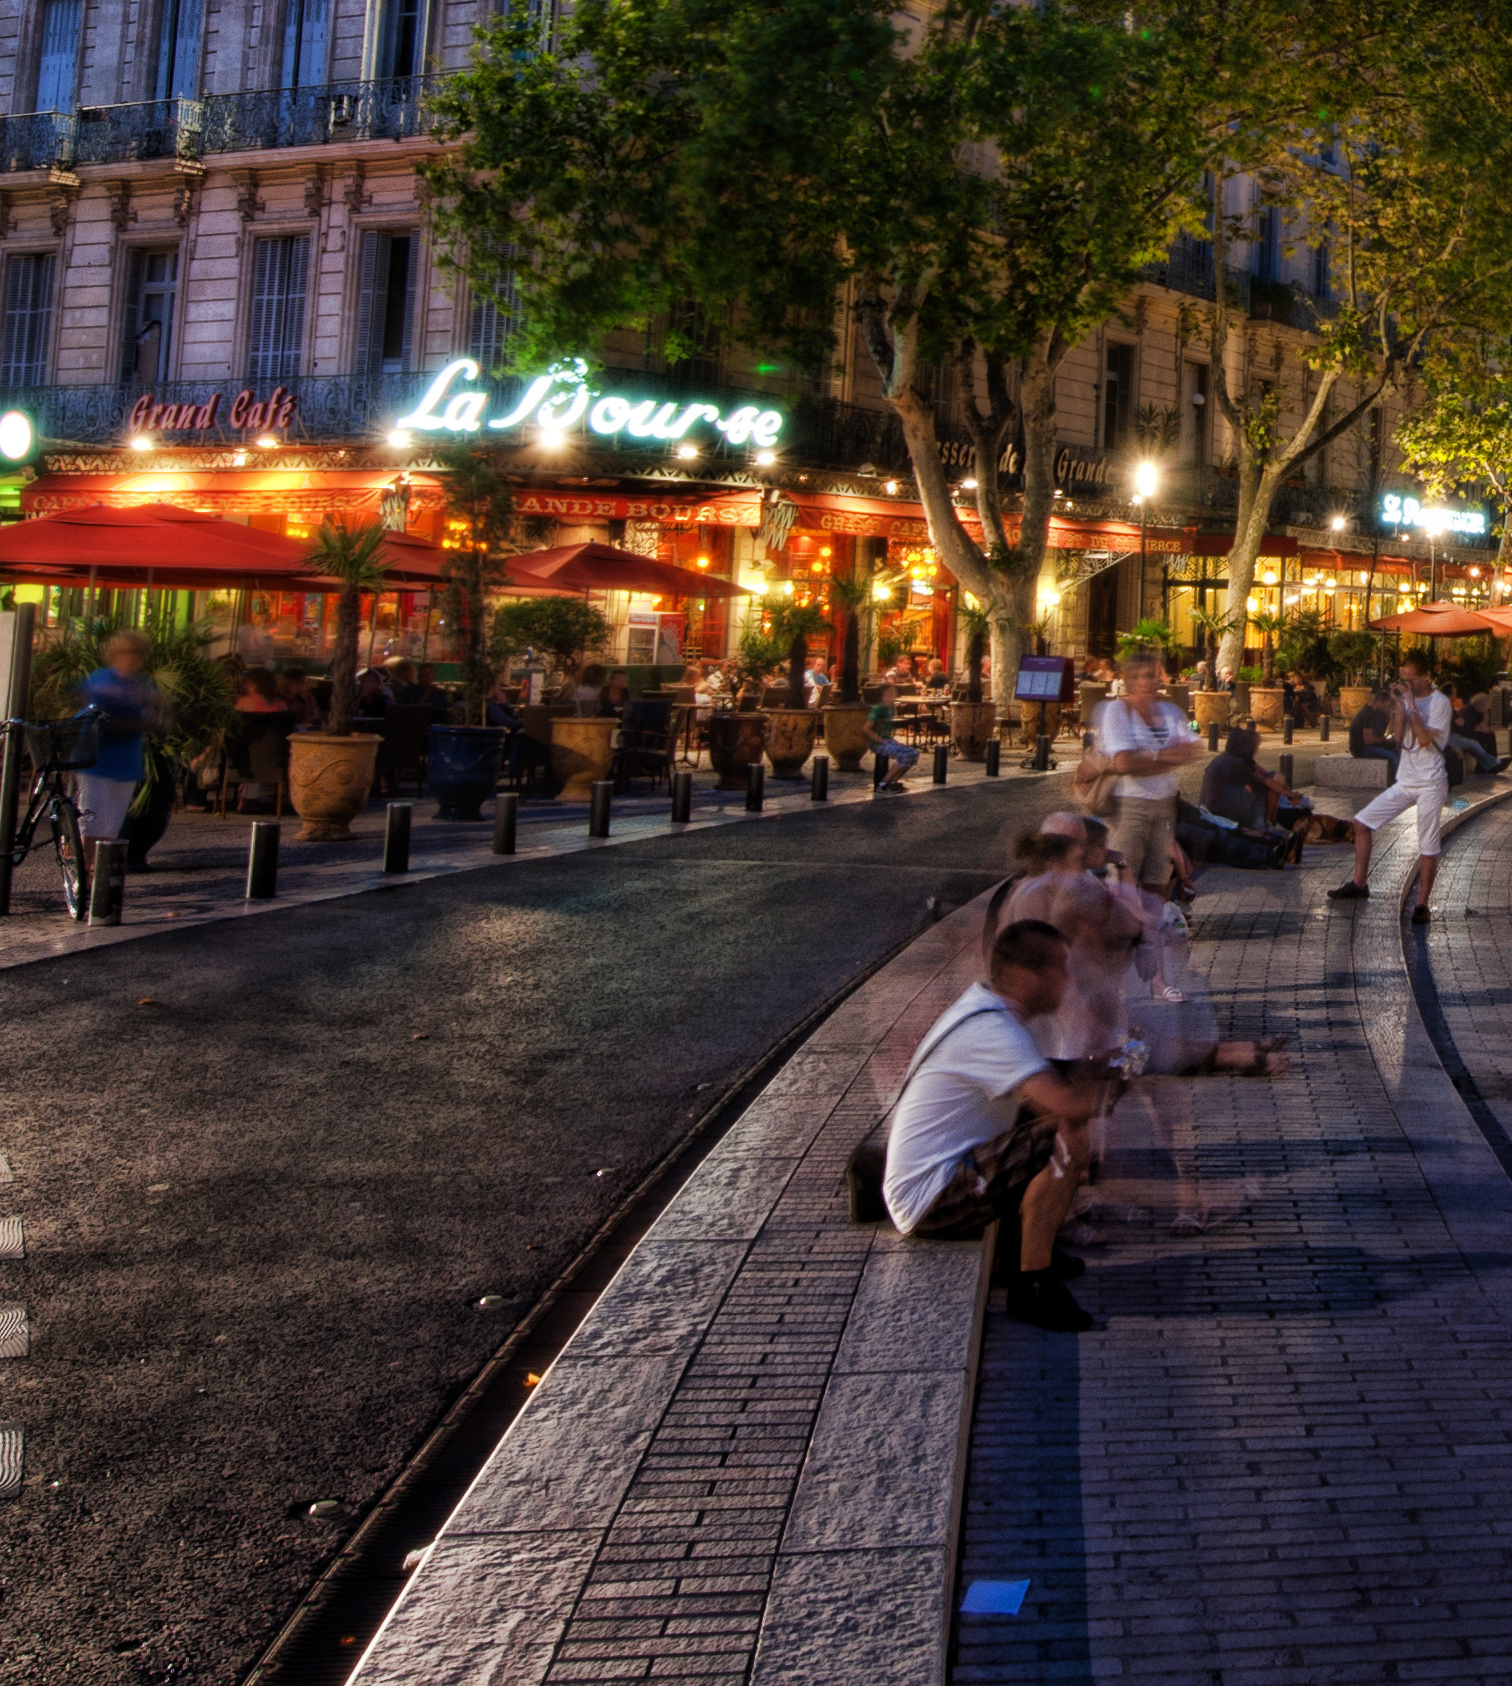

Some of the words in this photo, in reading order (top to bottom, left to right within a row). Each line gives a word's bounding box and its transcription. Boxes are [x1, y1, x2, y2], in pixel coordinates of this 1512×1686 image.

[129, 393, 223, 432] Grand
[230, 386, 297, 431] Café
[396, 358, 489, 432] La
[489, 356, 784, 447] Bourse
[999, 443, 1018, 474] de
[625, 501, 760, 523] BOURSE
